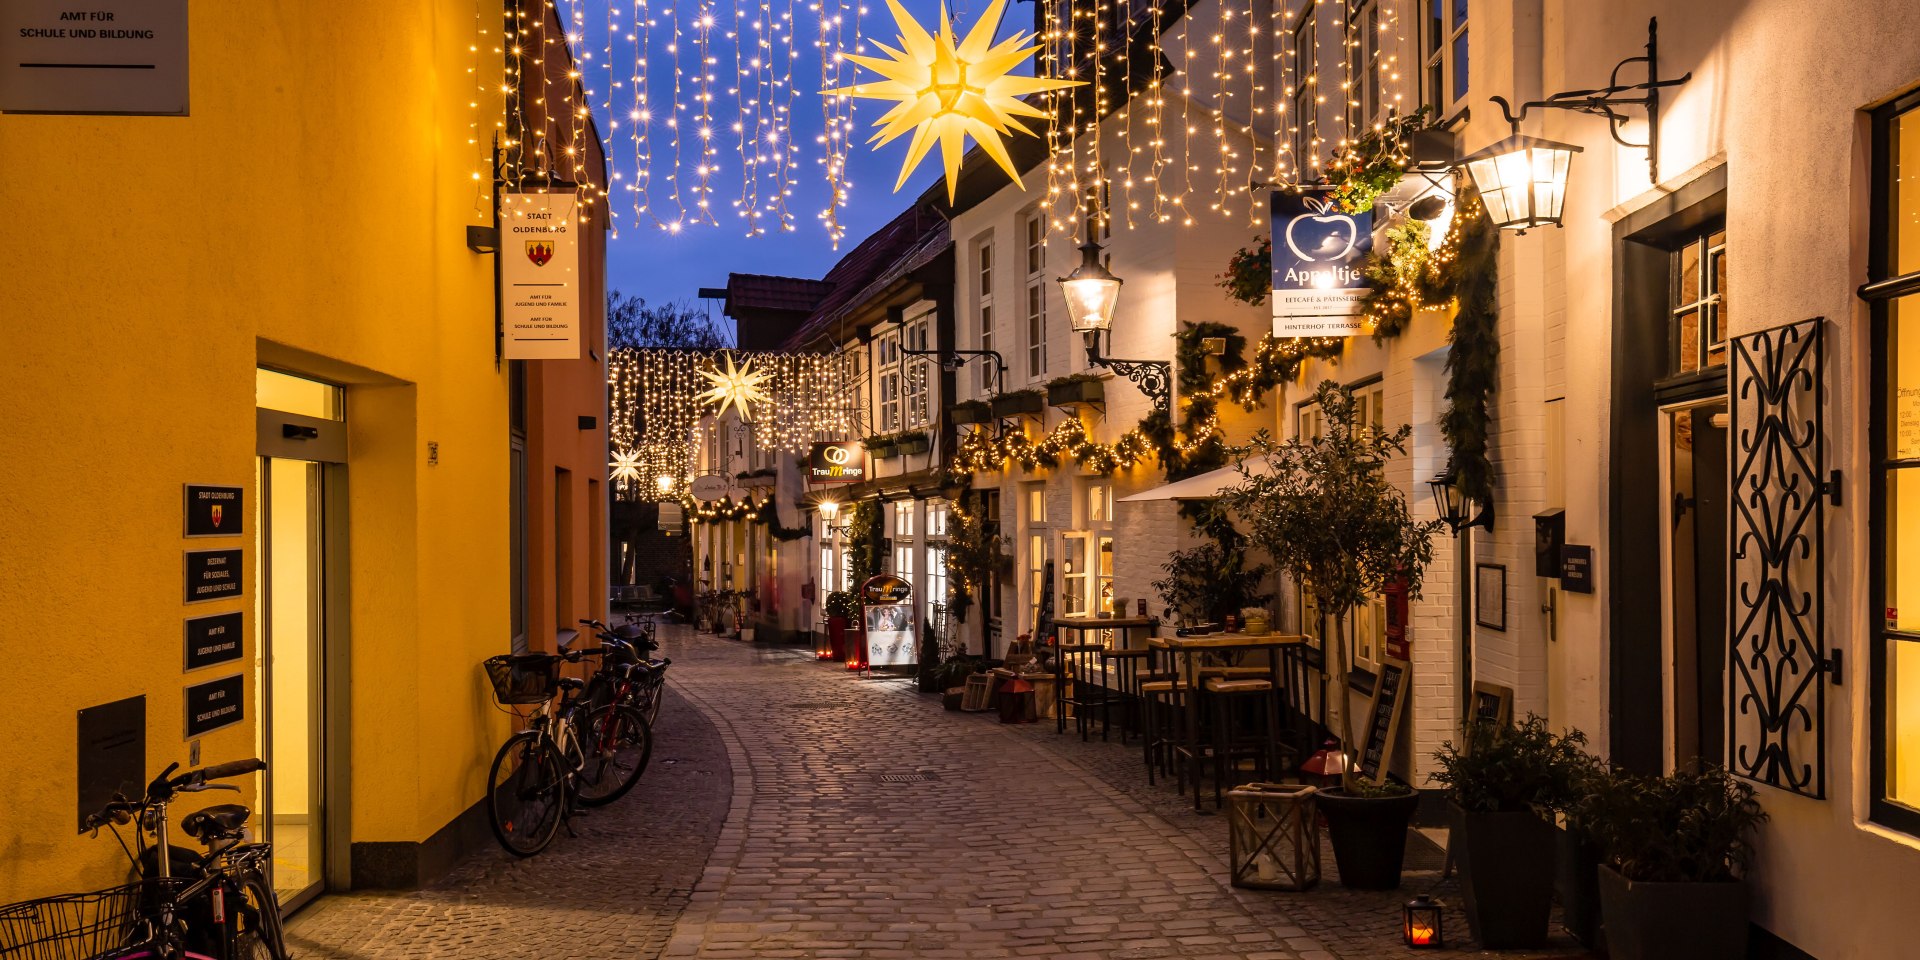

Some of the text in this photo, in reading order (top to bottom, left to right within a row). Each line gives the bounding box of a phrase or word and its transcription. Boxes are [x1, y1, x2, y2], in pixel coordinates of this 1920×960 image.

[60, 10, 115, 21] AMT FÜR
[20, 28, 154, 39] SCHULE UND BILDUNG
[1327, 322, 1362, 330] TERRASSE
[198, 491, 235, 500] STADT OLDENBURG
[203, 570, 211, 579] FÜR
[197, 582, 236, 594] JUGEND UND SCHULE
[209, 625, 225, 636] AMT FÜR
[197, 641, 236, 656] JUGEND UND FAMILIE
[209, 690, 225, 701] AMT FÜR
[197, 704, 237, 722] SCHULE UND BILDUNG
